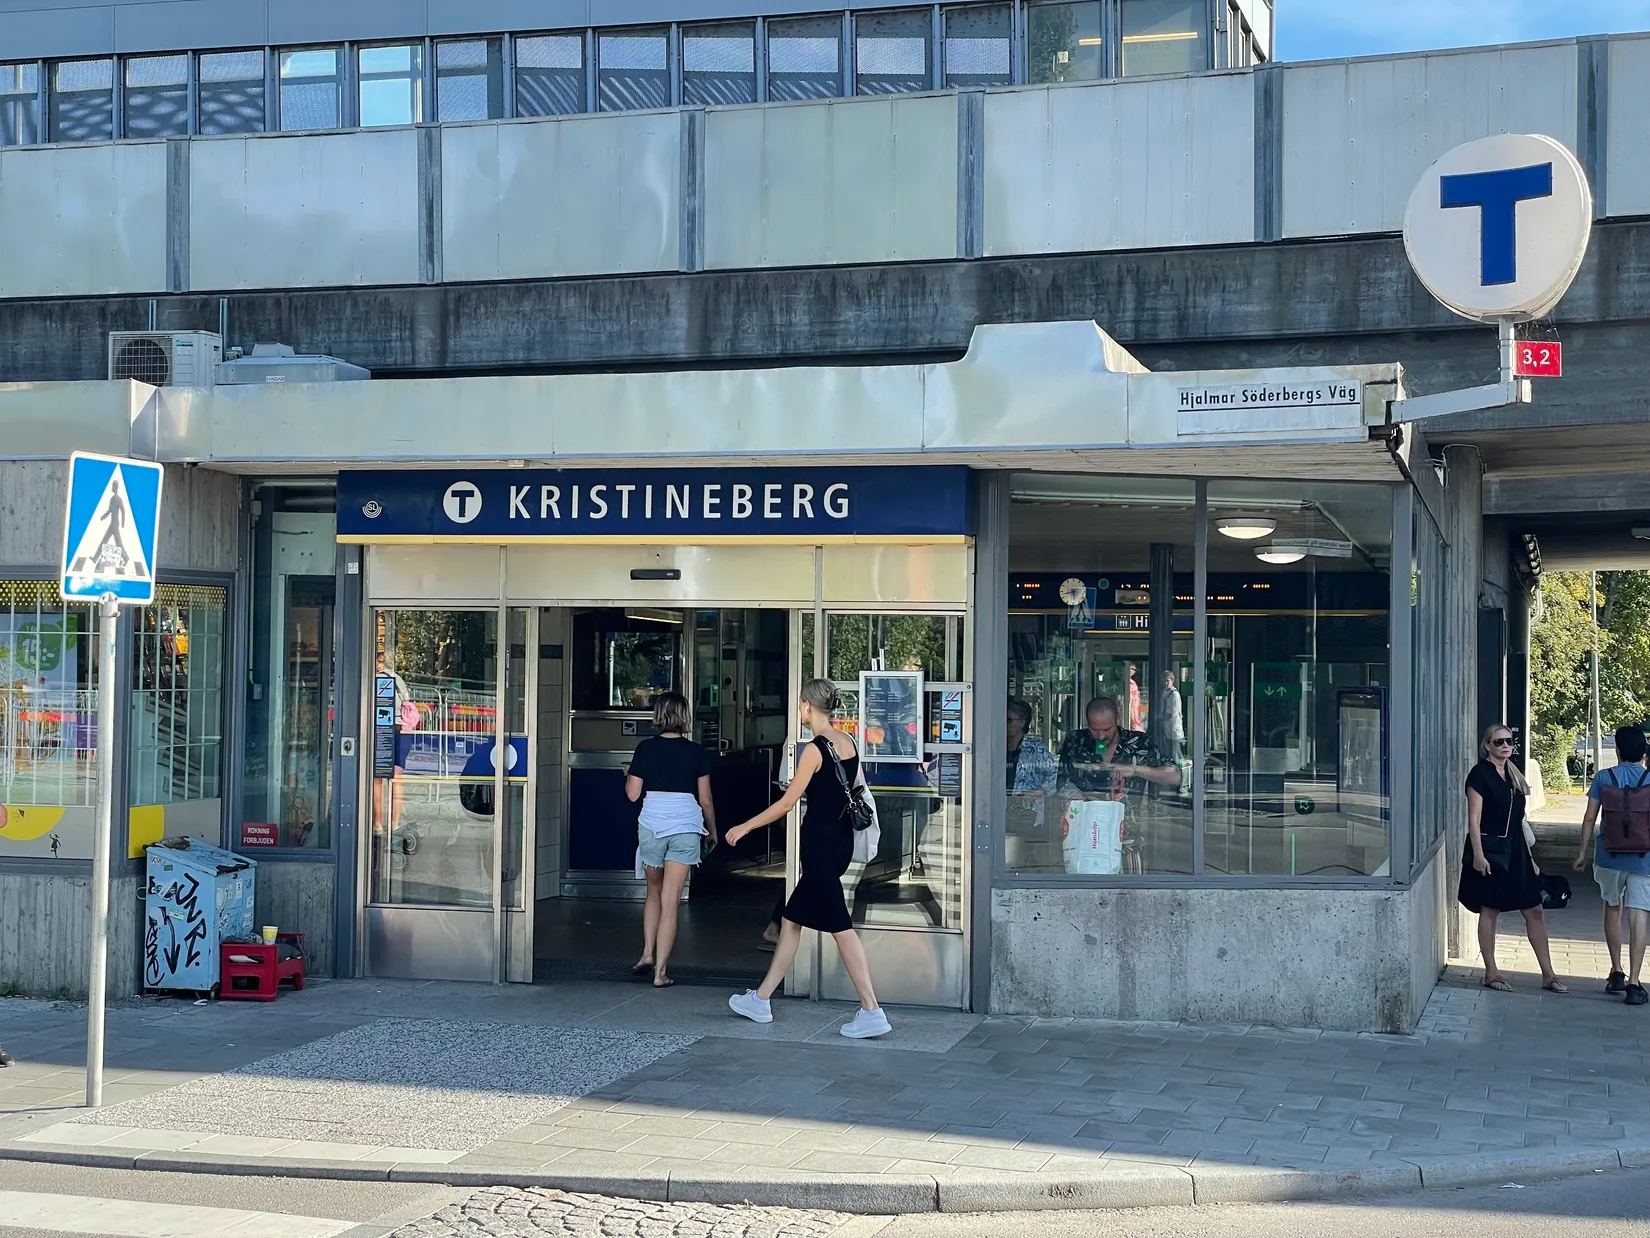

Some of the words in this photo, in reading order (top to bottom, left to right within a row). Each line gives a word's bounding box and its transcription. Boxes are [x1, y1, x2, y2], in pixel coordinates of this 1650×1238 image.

[1439, 161, 1553, 286] T
[1522, 348, 1551, 368] 3,2
[1180, 390, 1236, 409] Hjalmar
[1242, 387, 1322, 403] Söderbergs
[1328, 385, 1357, 402] Väg
[450, 489, 475, 518] T
[508, 483, 850, 520] KRISTINEBERG
[1135, 615, 1148, 628] Hi
